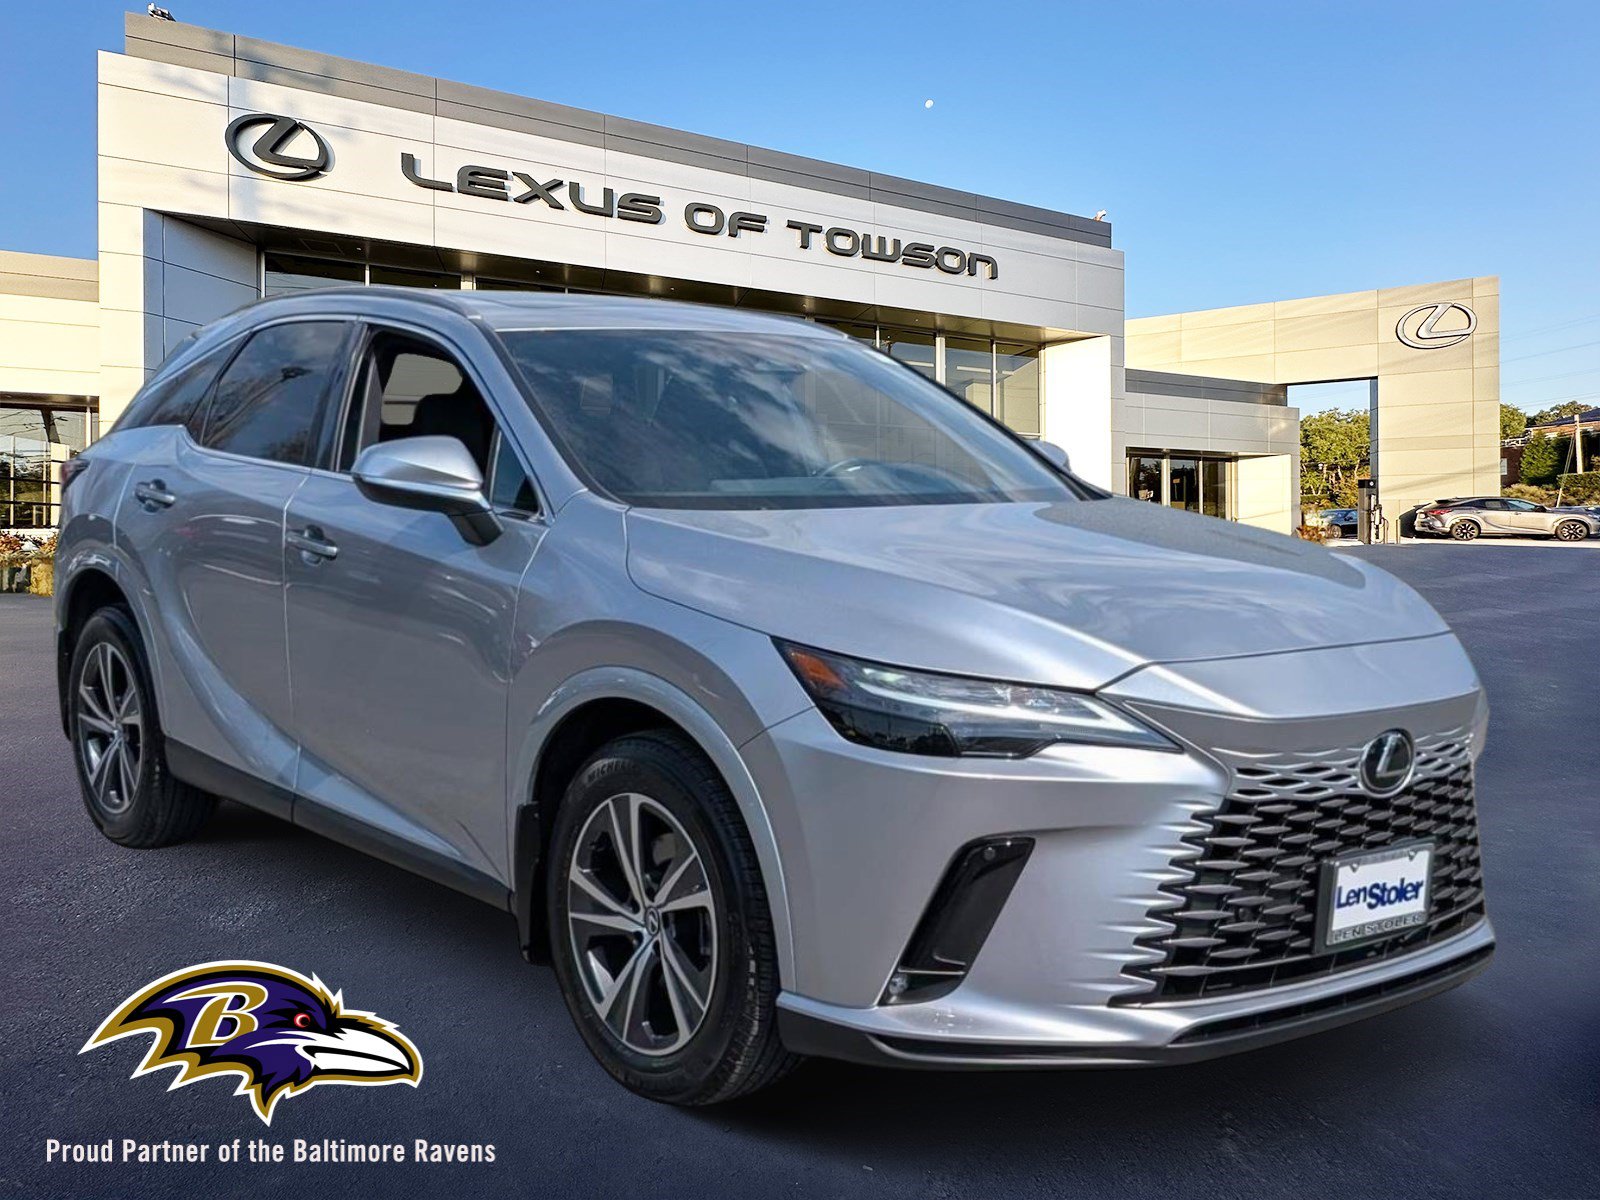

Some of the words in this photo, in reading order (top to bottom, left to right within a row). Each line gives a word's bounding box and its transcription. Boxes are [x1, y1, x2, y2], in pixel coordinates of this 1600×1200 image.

[400, 152, 663, 225] LEXUS
[684, 202, 768, 238] OF
[786, 219, 999, 280] TOWSON
